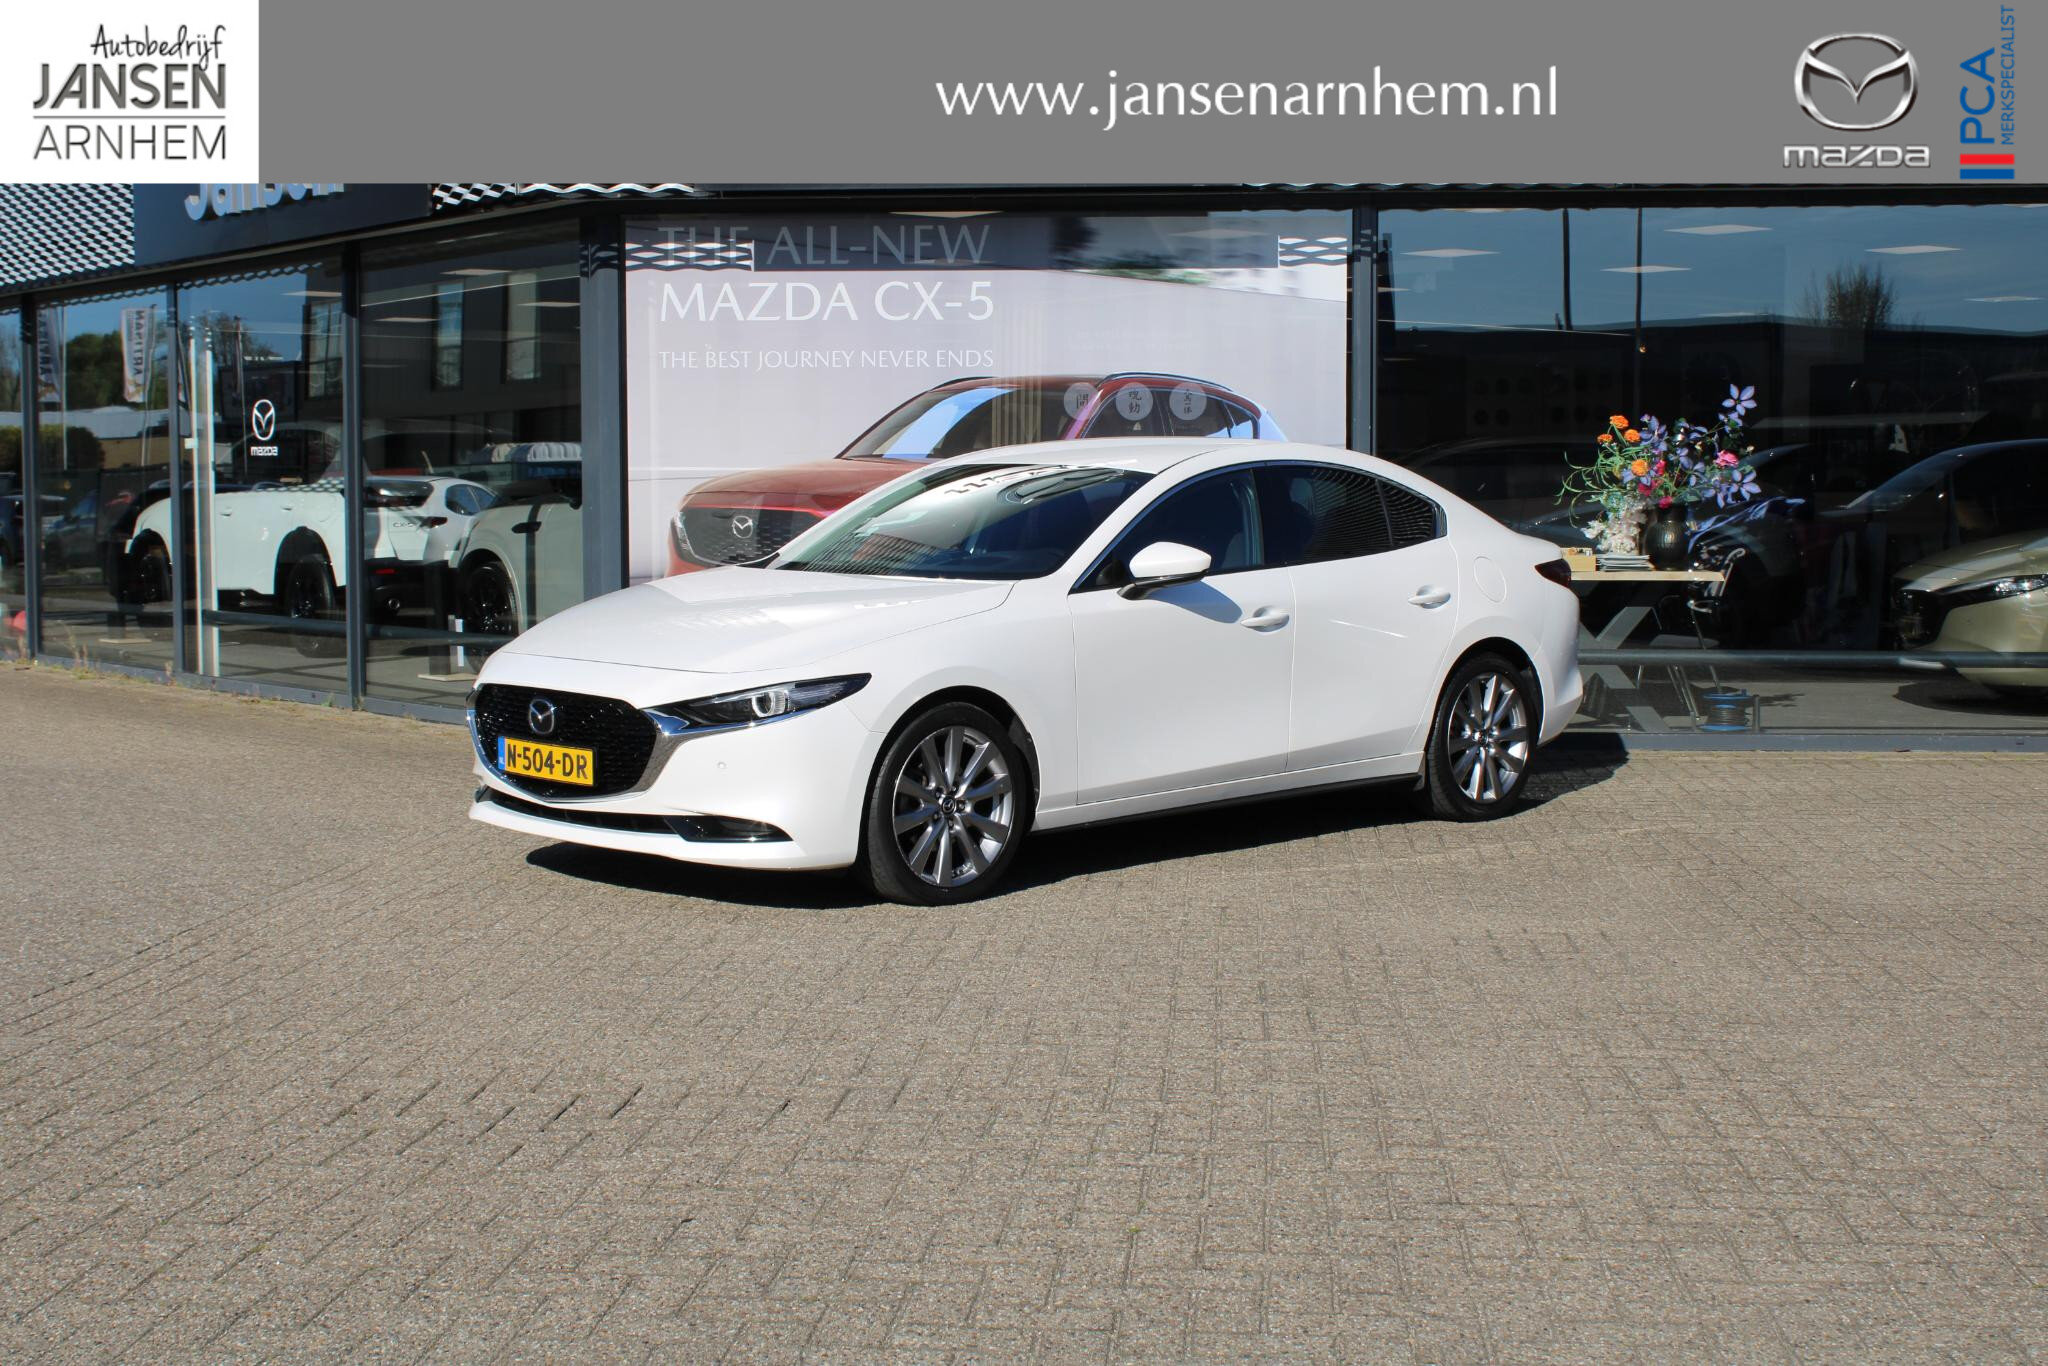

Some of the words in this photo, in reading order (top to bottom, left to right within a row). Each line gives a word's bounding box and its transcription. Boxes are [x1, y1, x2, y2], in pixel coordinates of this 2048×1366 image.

[657, 225, 750, 265] THE
[766, 224, 991, 265] ALL-NEW
[660, 281, 859, 322] MAZDA
[874, 280, 995, 322] CX-5
[659, 351, 698, 369] THE
[705, 351, 751, 369] BEST
[755, 350, 855, 372] JOURNEY
[861, 350, 928, 369] NEVER
[937, 350, 994, 369] ENDS
[507, 743, 588, 780] N-504-DR
